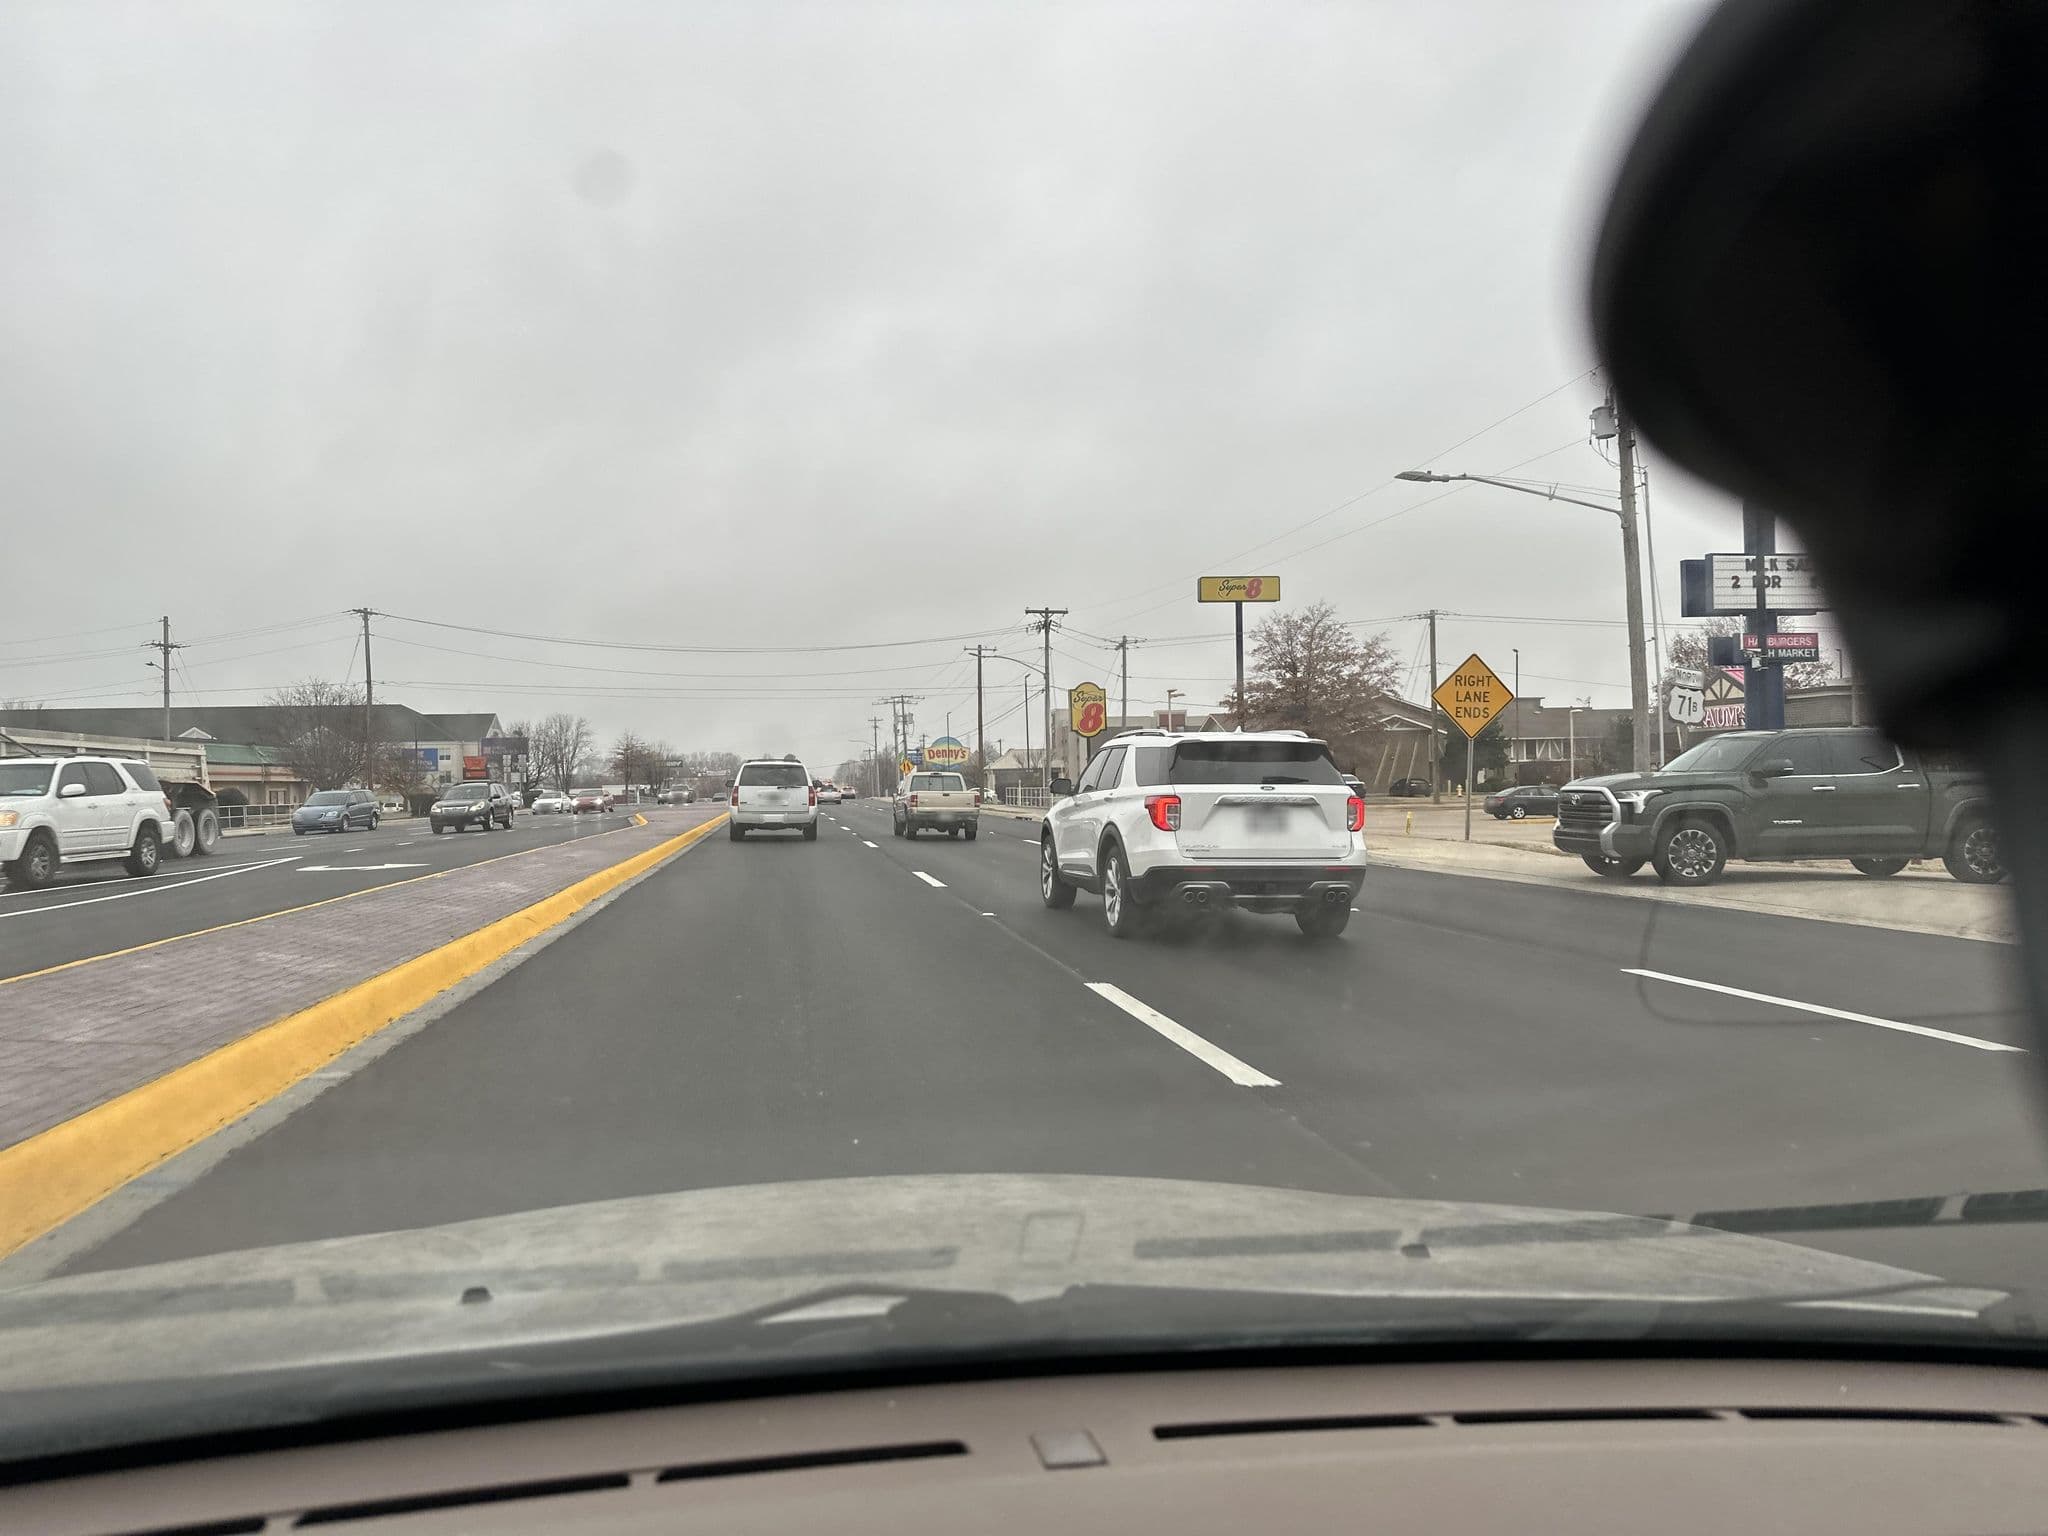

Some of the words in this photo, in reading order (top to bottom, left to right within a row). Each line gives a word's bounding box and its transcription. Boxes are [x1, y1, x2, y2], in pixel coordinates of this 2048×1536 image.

[1745, 558, 1779, 571] MK
[1731, 575, 1740, 588] 2
[1218, 579, 1247, 596] Super
[1246, 578, 1263, 599] 8
[1747, 636, 1813, 647] HBURGERS
[1778, 648, 1816, 658] MARKET
[1454, 674, 1492, 687] RIGHT
[1073, 690, 1103, 708] Super
[1455, 690, 1490, 702] LANE
[1079, 703, 1104, 733] 8
[1455, 706, 1490, 718] ENDS
[927, 748, 967, 760] Denny's
